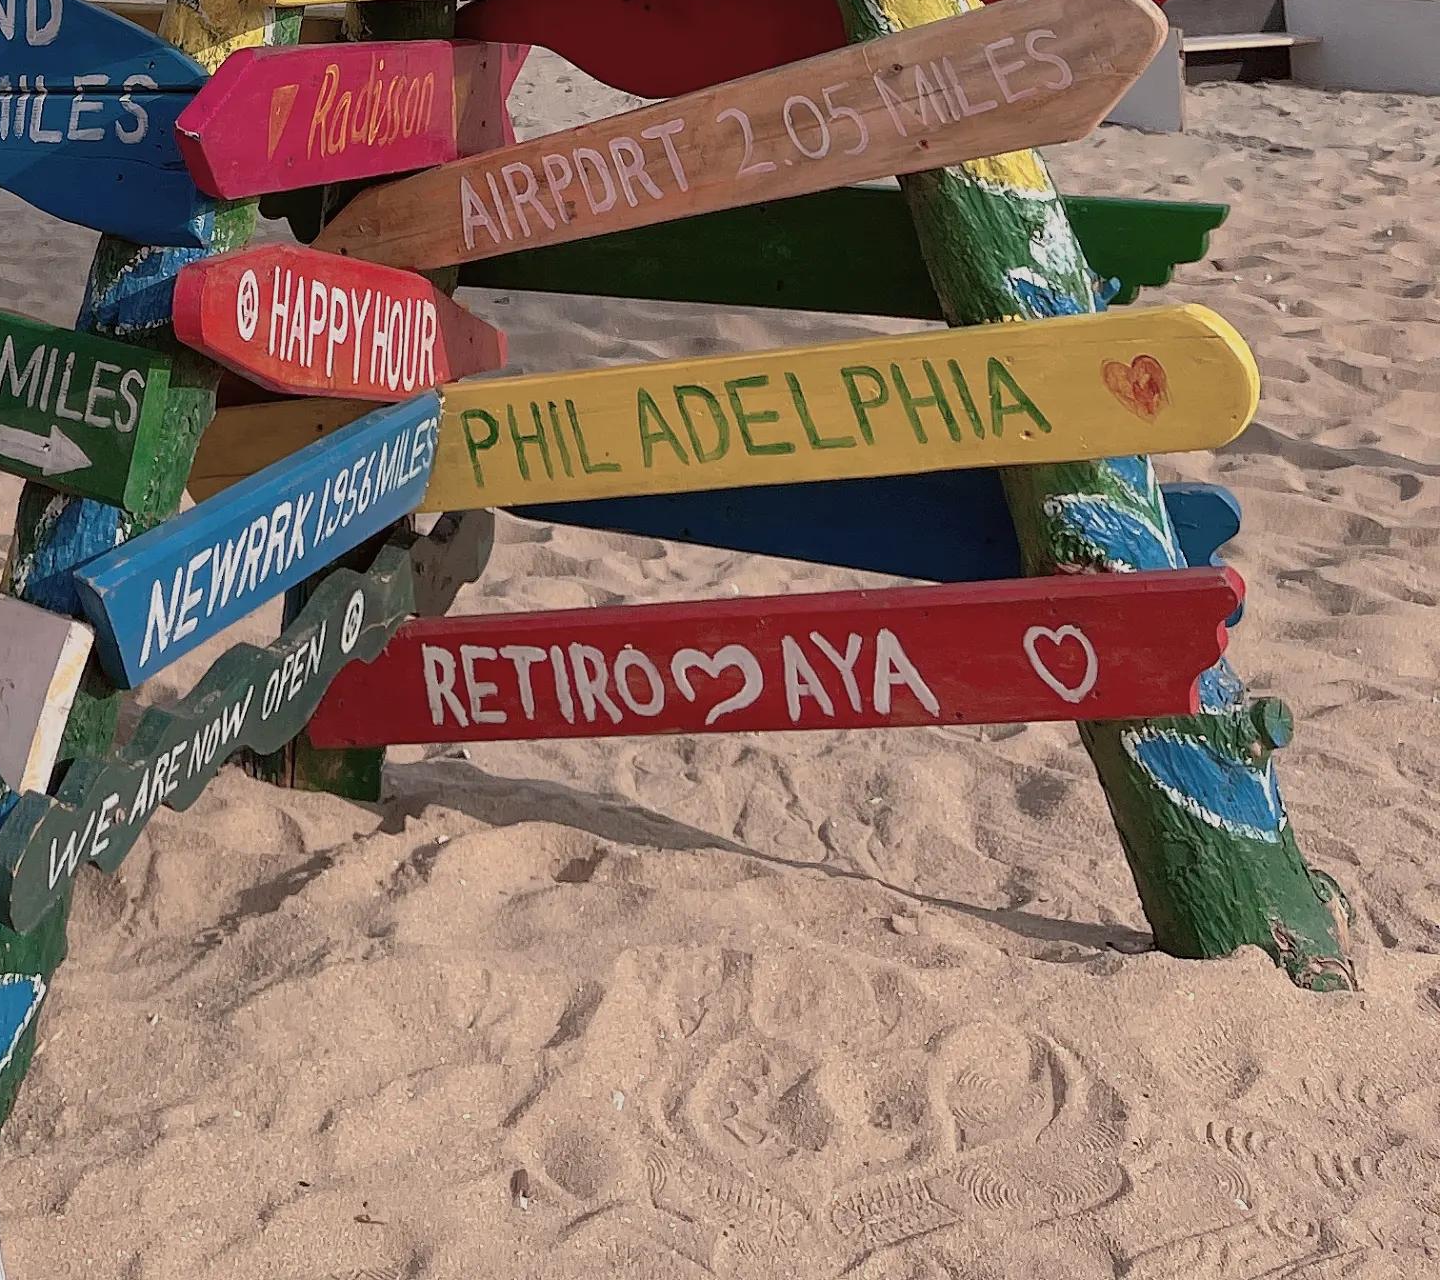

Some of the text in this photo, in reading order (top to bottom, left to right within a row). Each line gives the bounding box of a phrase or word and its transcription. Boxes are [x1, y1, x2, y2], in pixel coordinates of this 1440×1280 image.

[307, 52, 435, 160] Radisson
[716, 84, 869, 177] 2.05
[875, 28, 1074, 138] MILES
[371, 416, 439, 505] MILES
[421, 642, 666, 727] RETIRO
[48, 619, 327, 890] WE ARE NOW OPEN
